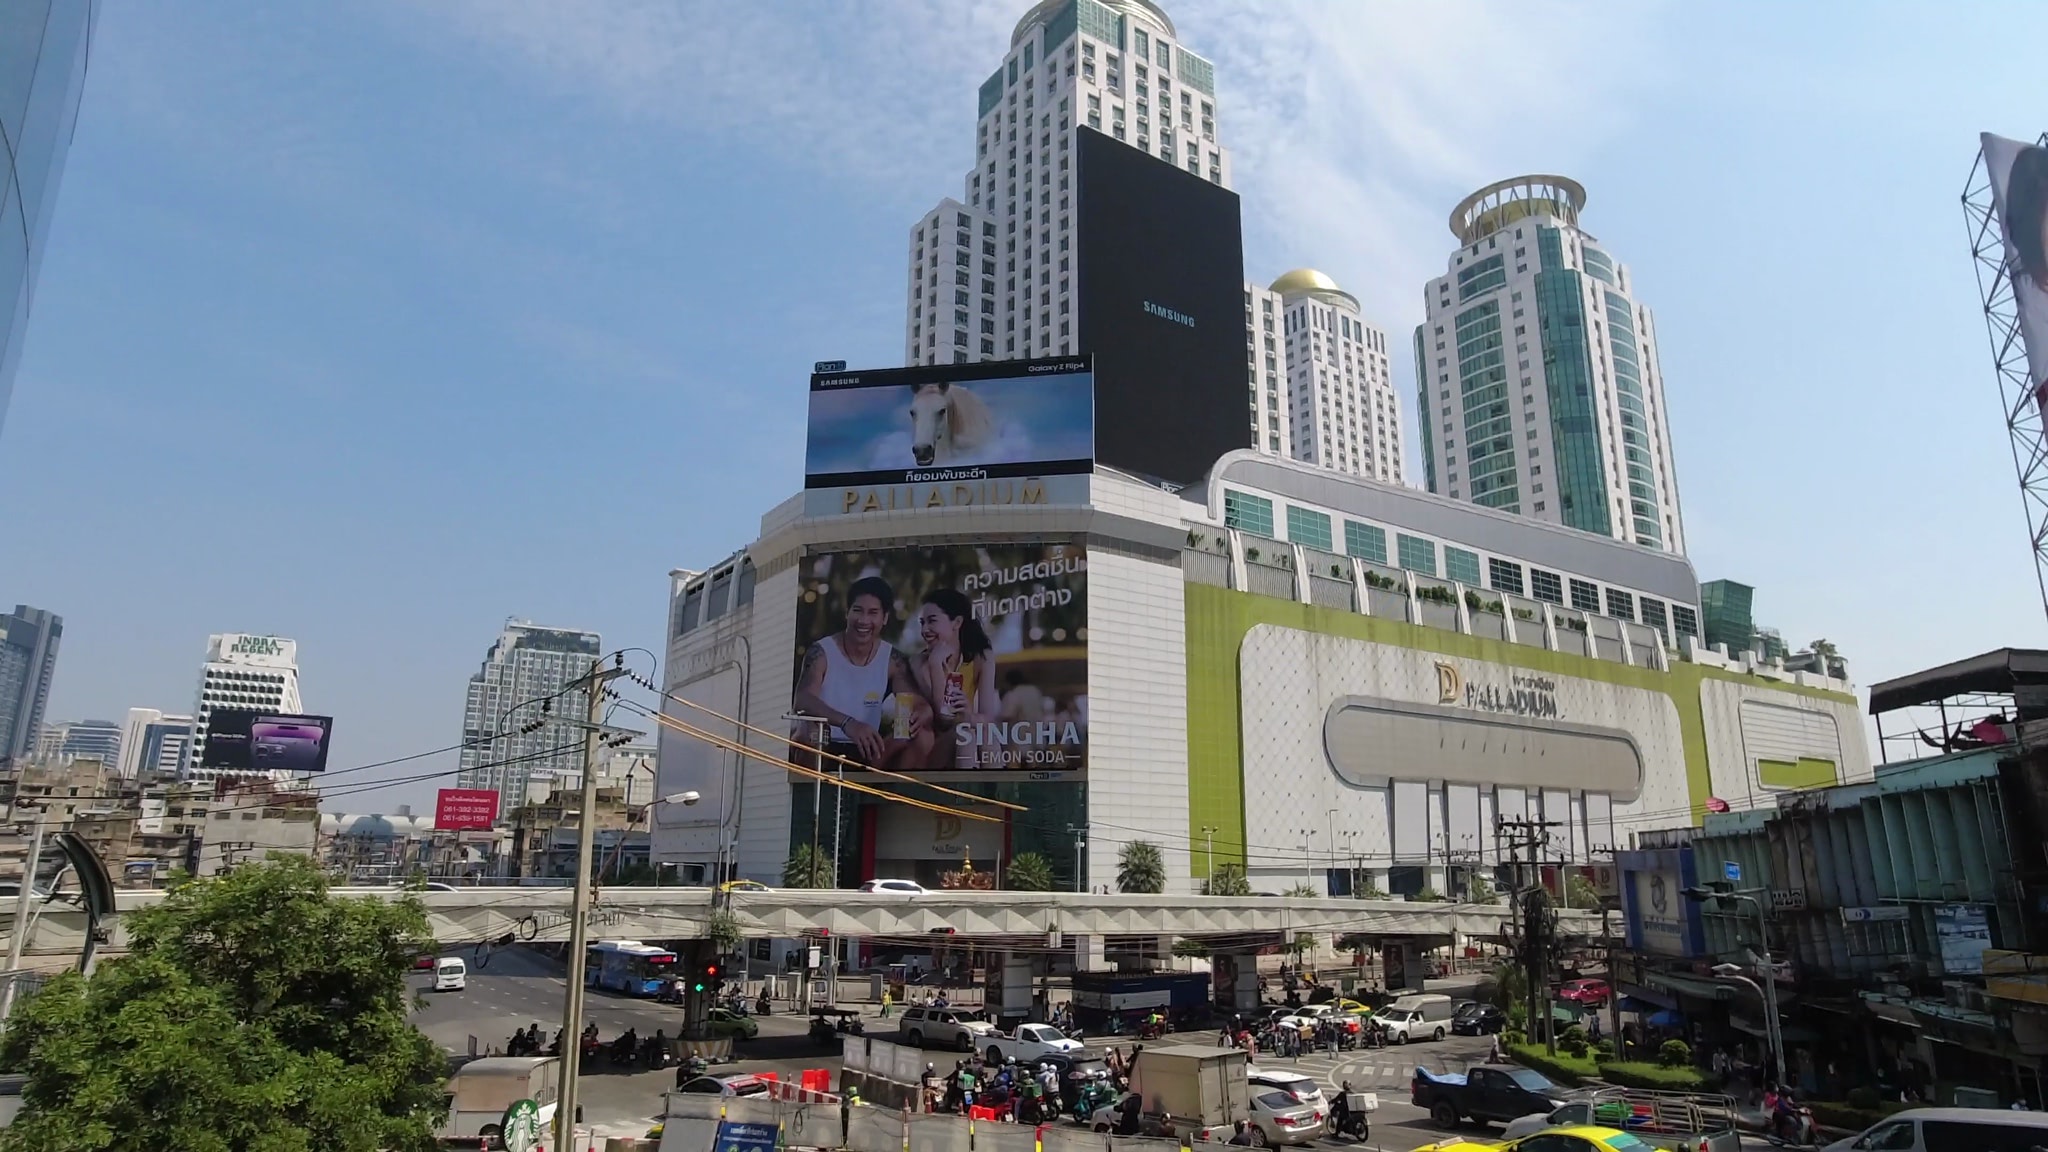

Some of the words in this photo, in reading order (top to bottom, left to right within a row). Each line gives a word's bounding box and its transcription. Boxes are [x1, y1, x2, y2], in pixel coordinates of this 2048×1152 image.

[1143, 300, 1195, 328] SAMSUNG
[1028, 364, 1059, 372] Galaxy
[1066, 361, 1085, 370] Flip4
[820, 377, 860, 386] SAMSUNG
[842, 482, 1048, 514] PALLADIUM
[964, 549, 1079, 591] ความสดชื่น
[971, 586, 1072, 620] ที่แตกต่าง
[231, 643, 284, 656] REGENT
[239, 635, 278, 648] INDRA
[1465, 681, 1557, 719] PALLADIUM
[955, 721, 1081, 746] SINGHA
[974, 751, 1022, 764] LEMON
[1025, 750, 1065, 763] SODA
